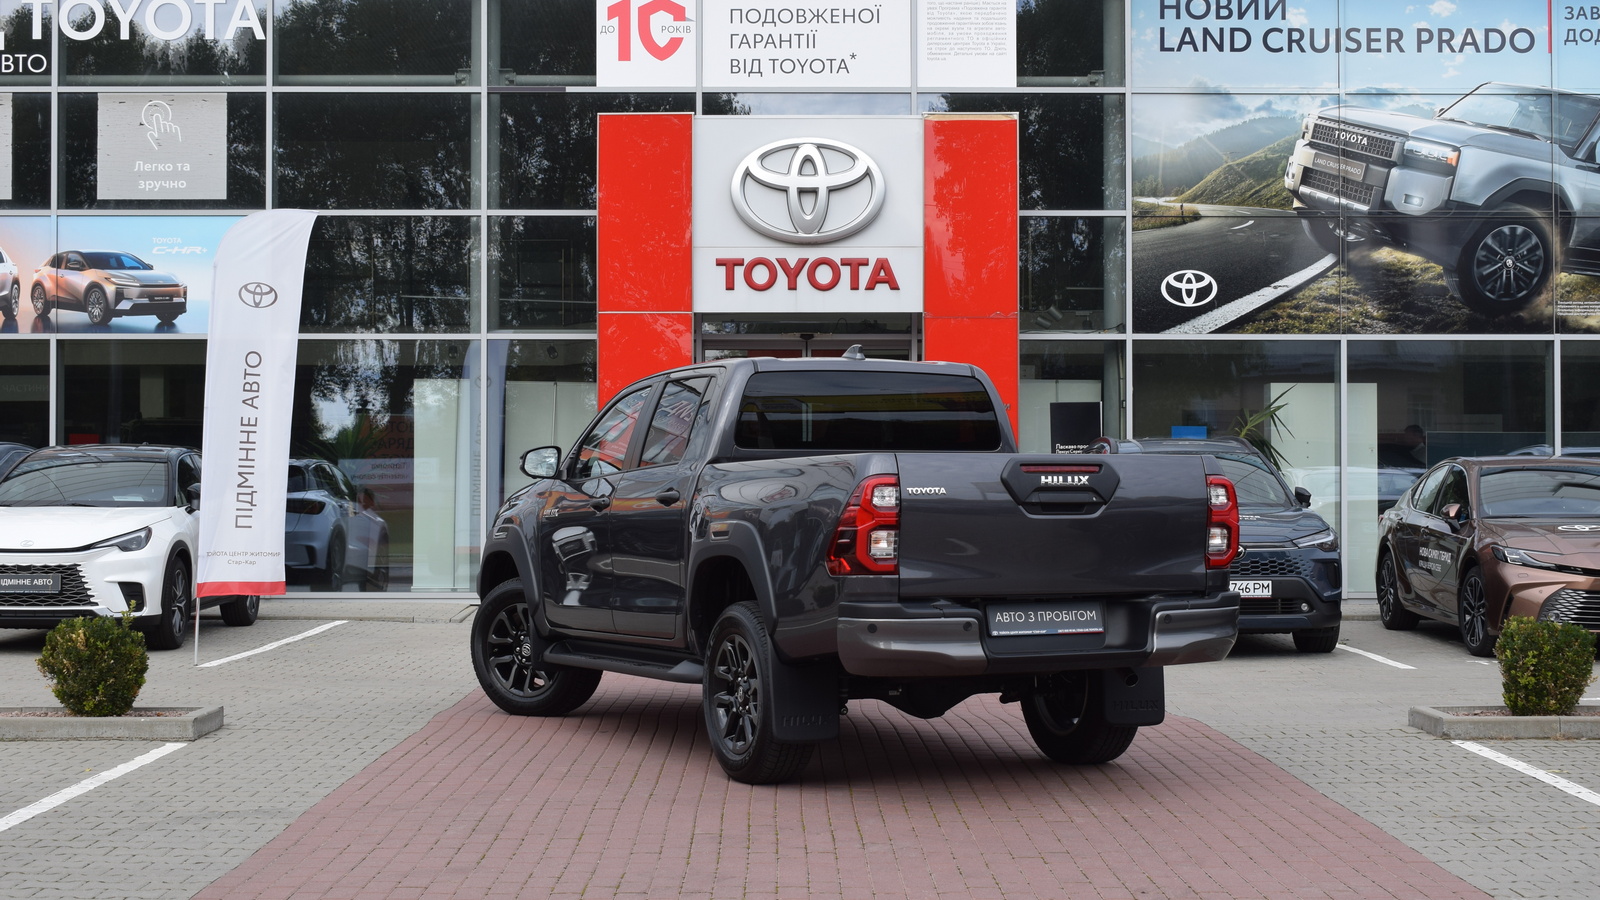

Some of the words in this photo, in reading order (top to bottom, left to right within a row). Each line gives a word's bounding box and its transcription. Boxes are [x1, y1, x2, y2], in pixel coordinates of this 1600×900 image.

[21, 0, 266, 41] TOYOTA
[730, 4, 882, 27] ПОДОВЖЕНОЇ
[600, 26, 615, 35] ДО
[661, 26, 691, 34] РОКІВ
[730, 29, 818, 49] ГАРАНТІЇ
[1159, 27, 1252, 53] LAND
[1262, 27, 1405, 53] CRUISER
[1416, 27, 1536, 53] PRADO
[730, 58, 763, 77] ВІД
[1335, 131, 1368, 146] TOYOTA
[134, 161, 173, 172] Легко
[176, 162, 190, 172] та
[1314, 157, 1326, 166] LAND
[1326, 160, 1347, 171] CRUISER
[1346, 166, 1361, 175] PRADO
[138, 180, 187, 191] зручно
[715, 256, 901, 292] TOYOTA
[241, 350, 262, 410] АВТО
[234, 416, 258, 529] ПІДМІННЕ
[1040, 475, 1089, 486] HILUX
[906, 486, 947, 495] TOYOTA
[33, 578, 53, 586] АВТО
[1253, 582, 1270, 594] PM
[995, 611, 1025, 623] АВТО
[1028, 611, 1035, 622] З
[1038, 610, 1097, 622] ПРОБІГОМ
